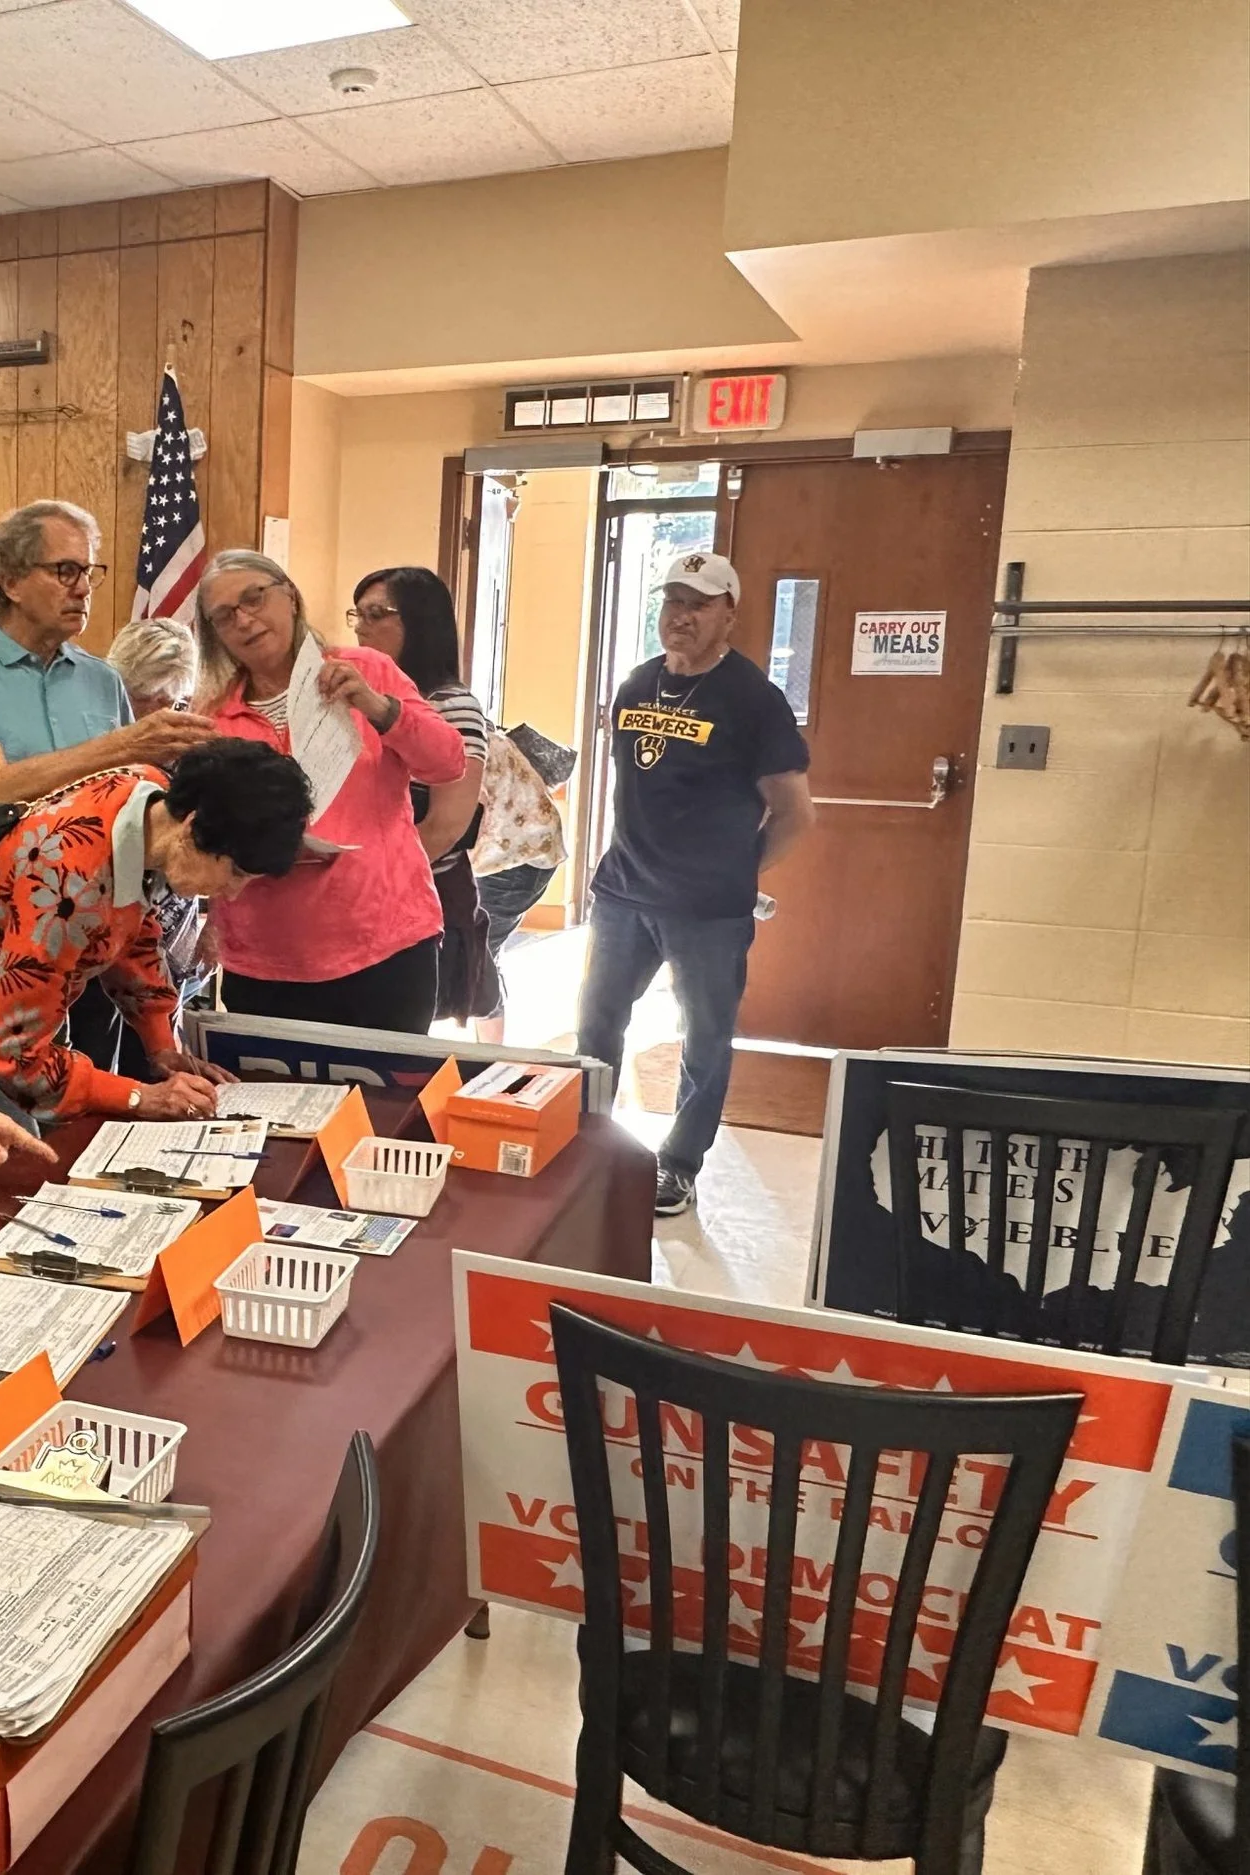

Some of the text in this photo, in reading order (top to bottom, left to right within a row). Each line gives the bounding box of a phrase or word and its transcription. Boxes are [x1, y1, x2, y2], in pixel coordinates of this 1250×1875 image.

[707, 375, 774, 428] EXIT
[859, 621, 941, 634] CARRY OUT
[873, 634, 939, 653] MEALS
[623, 712, 701, 738] BREWERS
[526, 1381, 704, 1454] GUN
